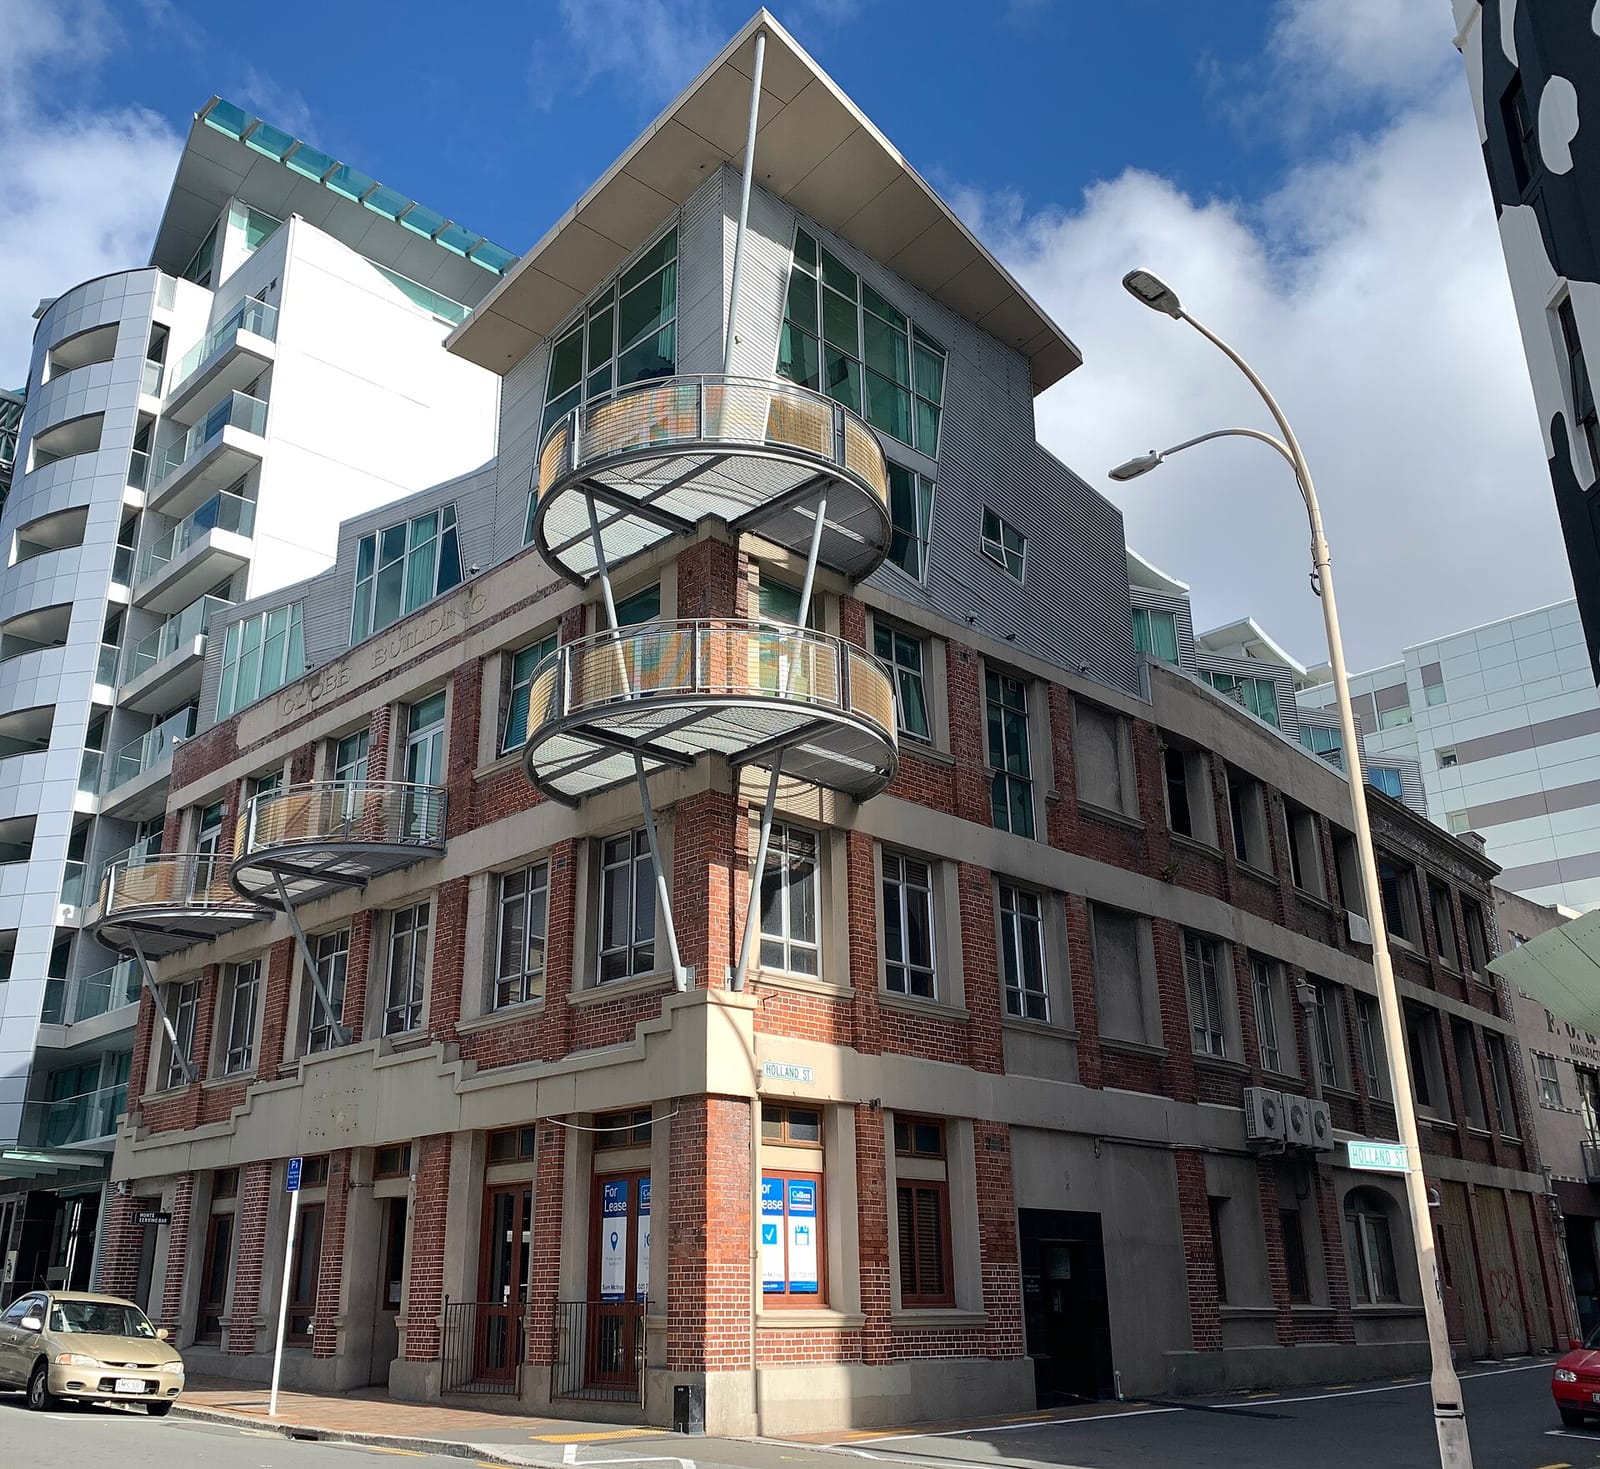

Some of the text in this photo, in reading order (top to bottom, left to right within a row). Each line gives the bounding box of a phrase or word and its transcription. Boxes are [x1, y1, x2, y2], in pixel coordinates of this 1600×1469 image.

[282, 593, 487, 717] GLOBE BUILDING
[765, 1064, 811, 1081] HOLLAND ST
[1351, 1147, 1405, 1166] HOLLAND ST
[604, 1184, 618, 1198] For
[761, 1183, 772, 1195] or
[604, 1199, 627, 1213] Lease
[761, 1199, 783, 1211] ease
